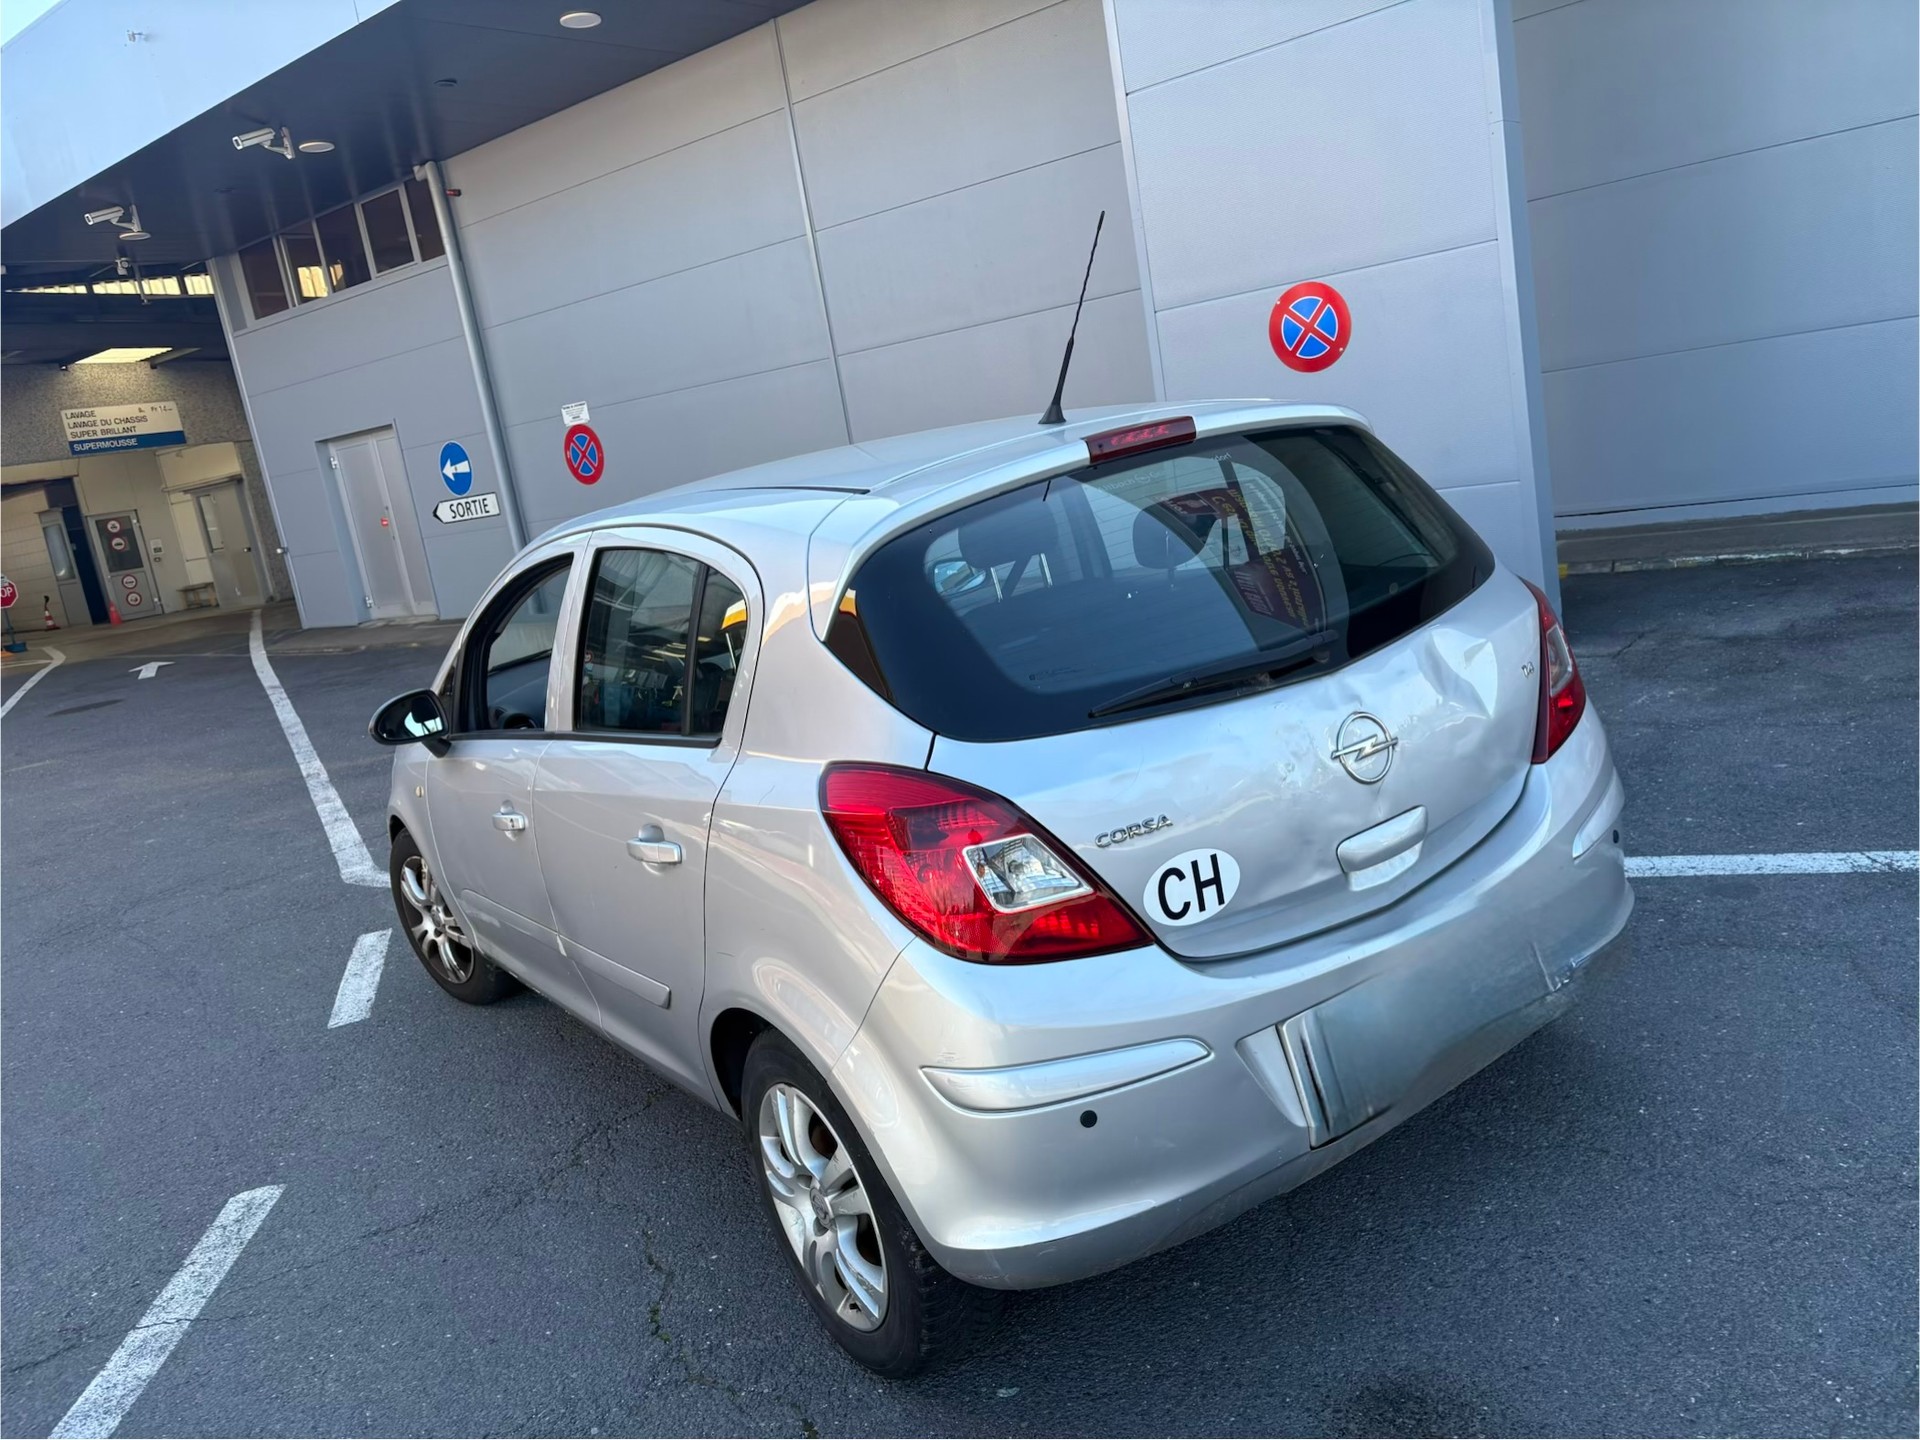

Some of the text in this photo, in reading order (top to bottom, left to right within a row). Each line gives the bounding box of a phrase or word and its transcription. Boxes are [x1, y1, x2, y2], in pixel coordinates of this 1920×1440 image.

[65, 410, 96, 420] LAVAGE
[67, 415, 149, 429] LAVAGE DU CHASSIS
[70, 426, 137, 439] SUPER BRILLANT
[73, 438, 138, 451] SUPERMOUSSE
[449, 498, 490, 519] SORTIE
[1095, 814, 1173, 848] CORSA
[1158, 853, 1225, 920] CH
